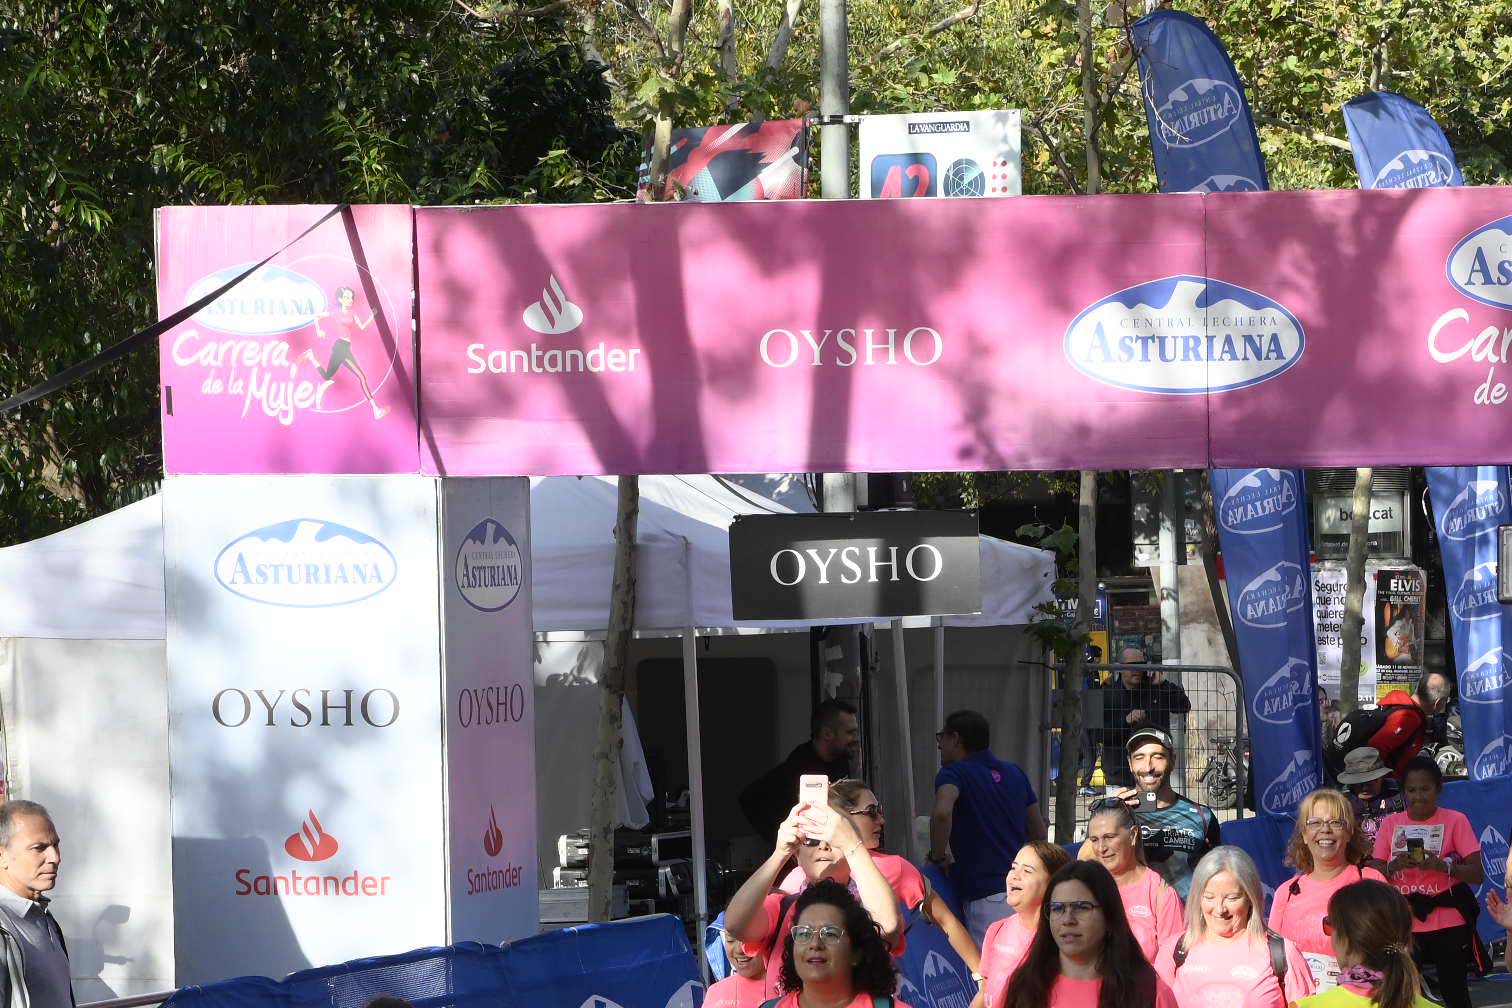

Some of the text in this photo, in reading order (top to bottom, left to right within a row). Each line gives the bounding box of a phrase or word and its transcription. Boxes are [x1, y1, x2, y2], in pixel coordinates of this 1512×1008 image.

[919, 121, 969, 132] VANGUARDIA
[1120, 315, 1278, 329] CENTRAL LECHERA
[171, 329, 290, 368] Carrera
[466, 343, 641, 374] Santander
[758, 326, 943, 368] OYSHO
[1086, 321, 1287, 363] ASTURIANA
[201, 364, 335, 425] de la Mujer
[1473, 366, 1508, 406] de
[229, 552, 384, 585] ASTURIANA
[461, 554, 519, 588] ASTURIANA
[769, 544, 943, 586] OYSHO
[1315, 594, 1331, 607] que
[1390, 579, 1421, 592] ELVIS
[1317, 635, 1336, 646] este
[212, 688, 400, 728] OYSHO
[458, 683, 524, 728] OYSHO
[236, 869, 390, 896] Santander
[467, 862, 522, 895] Santander
